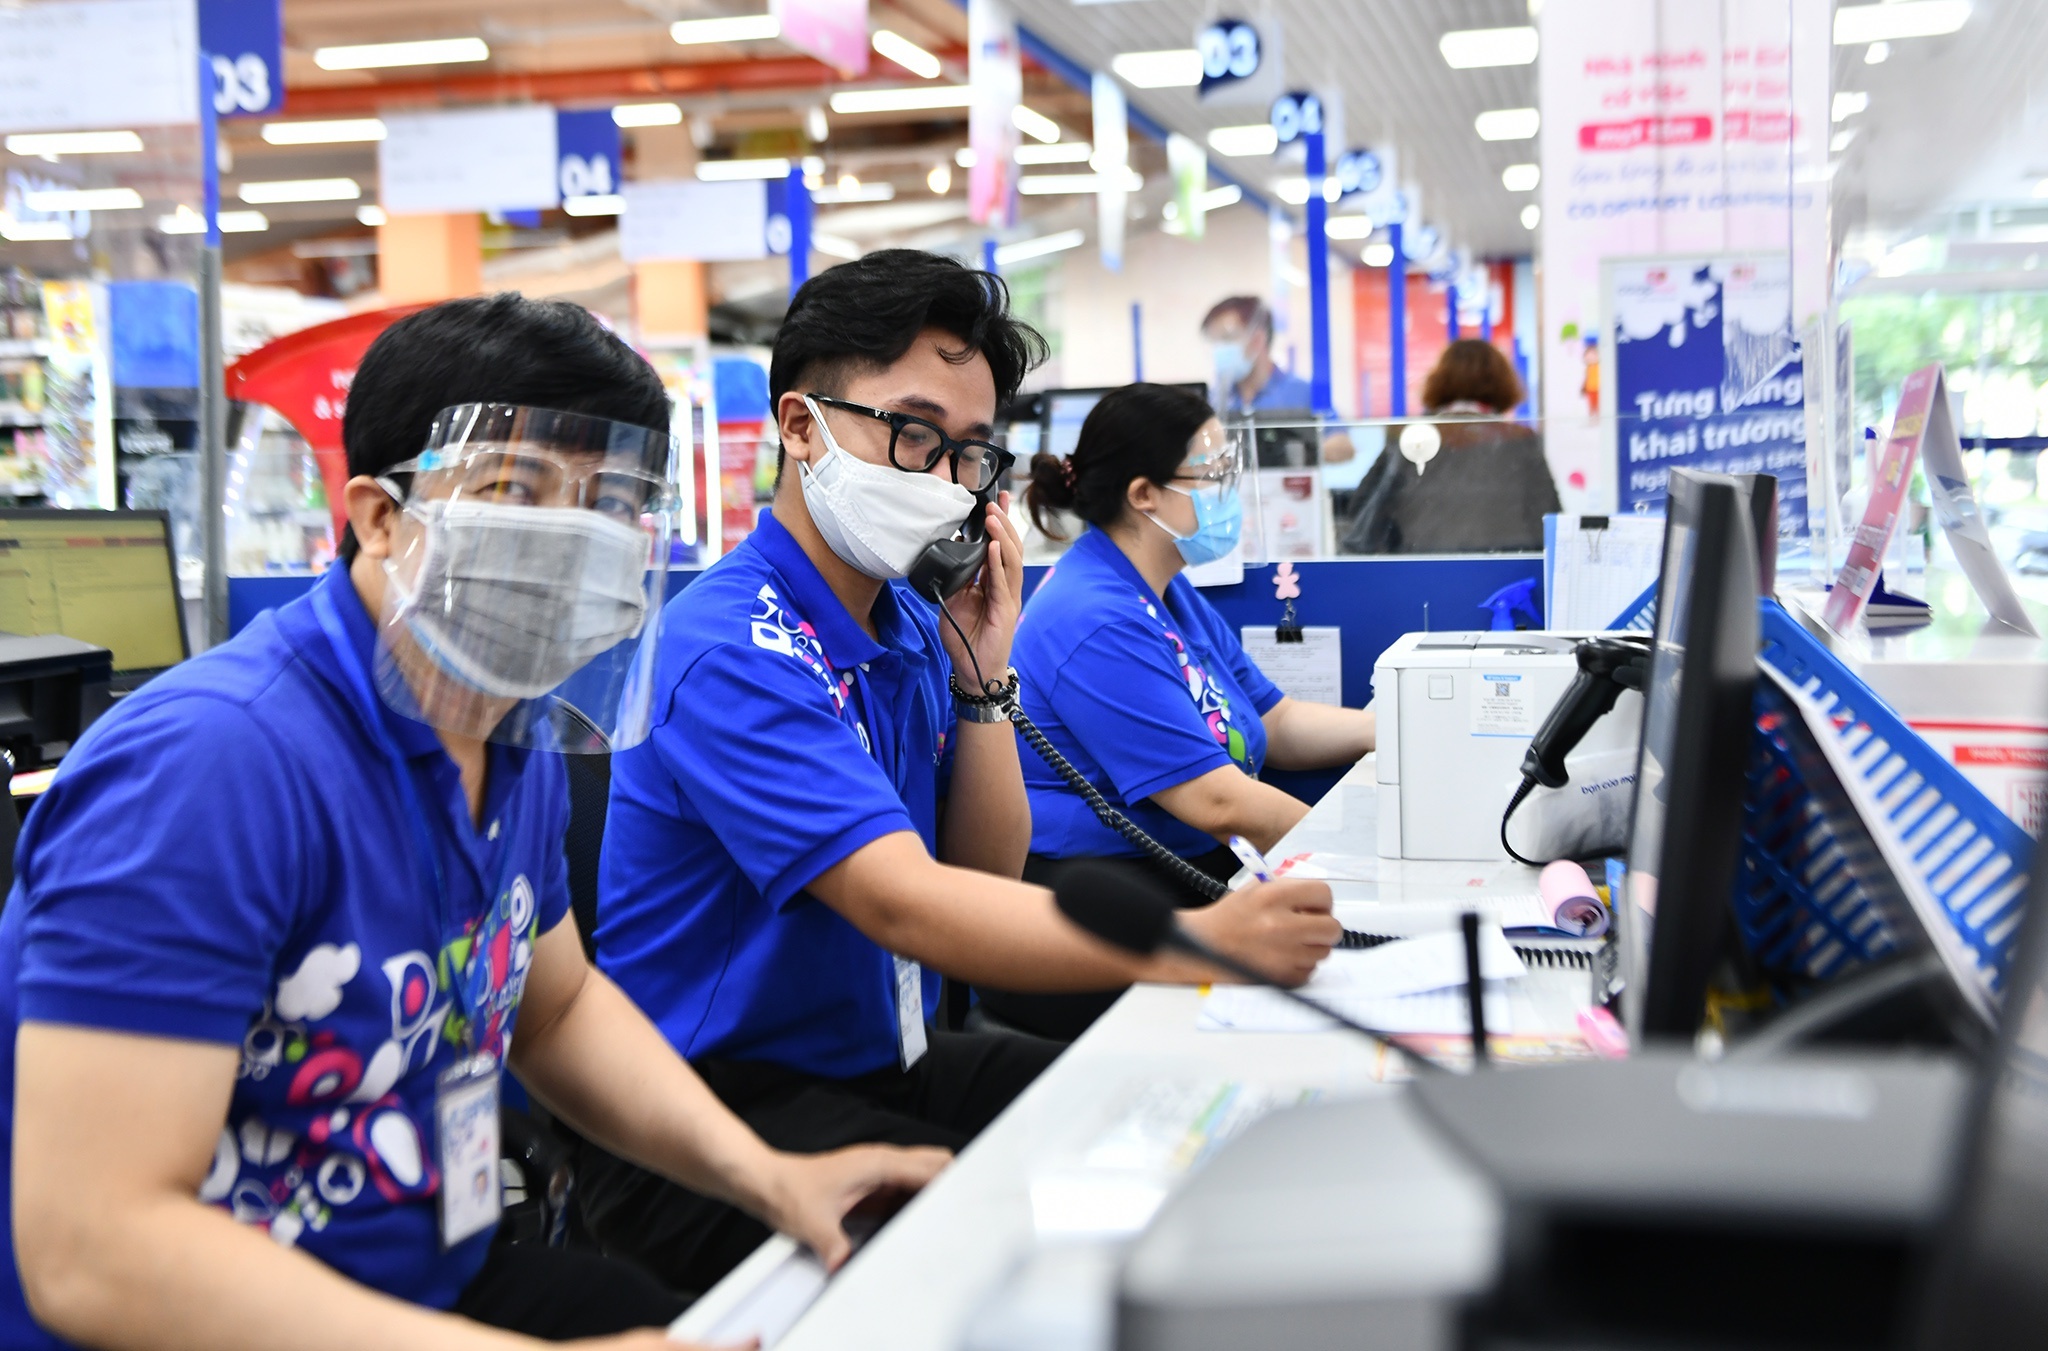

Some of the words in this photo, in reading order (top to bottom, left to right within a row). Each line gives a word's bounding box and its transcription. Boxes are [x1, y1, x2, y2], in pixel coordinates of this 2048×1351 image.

[1201, 25, 1258, 78] 03
[561, 152, 612, 198] 04
[1629, 424, 1698, 463] khai
